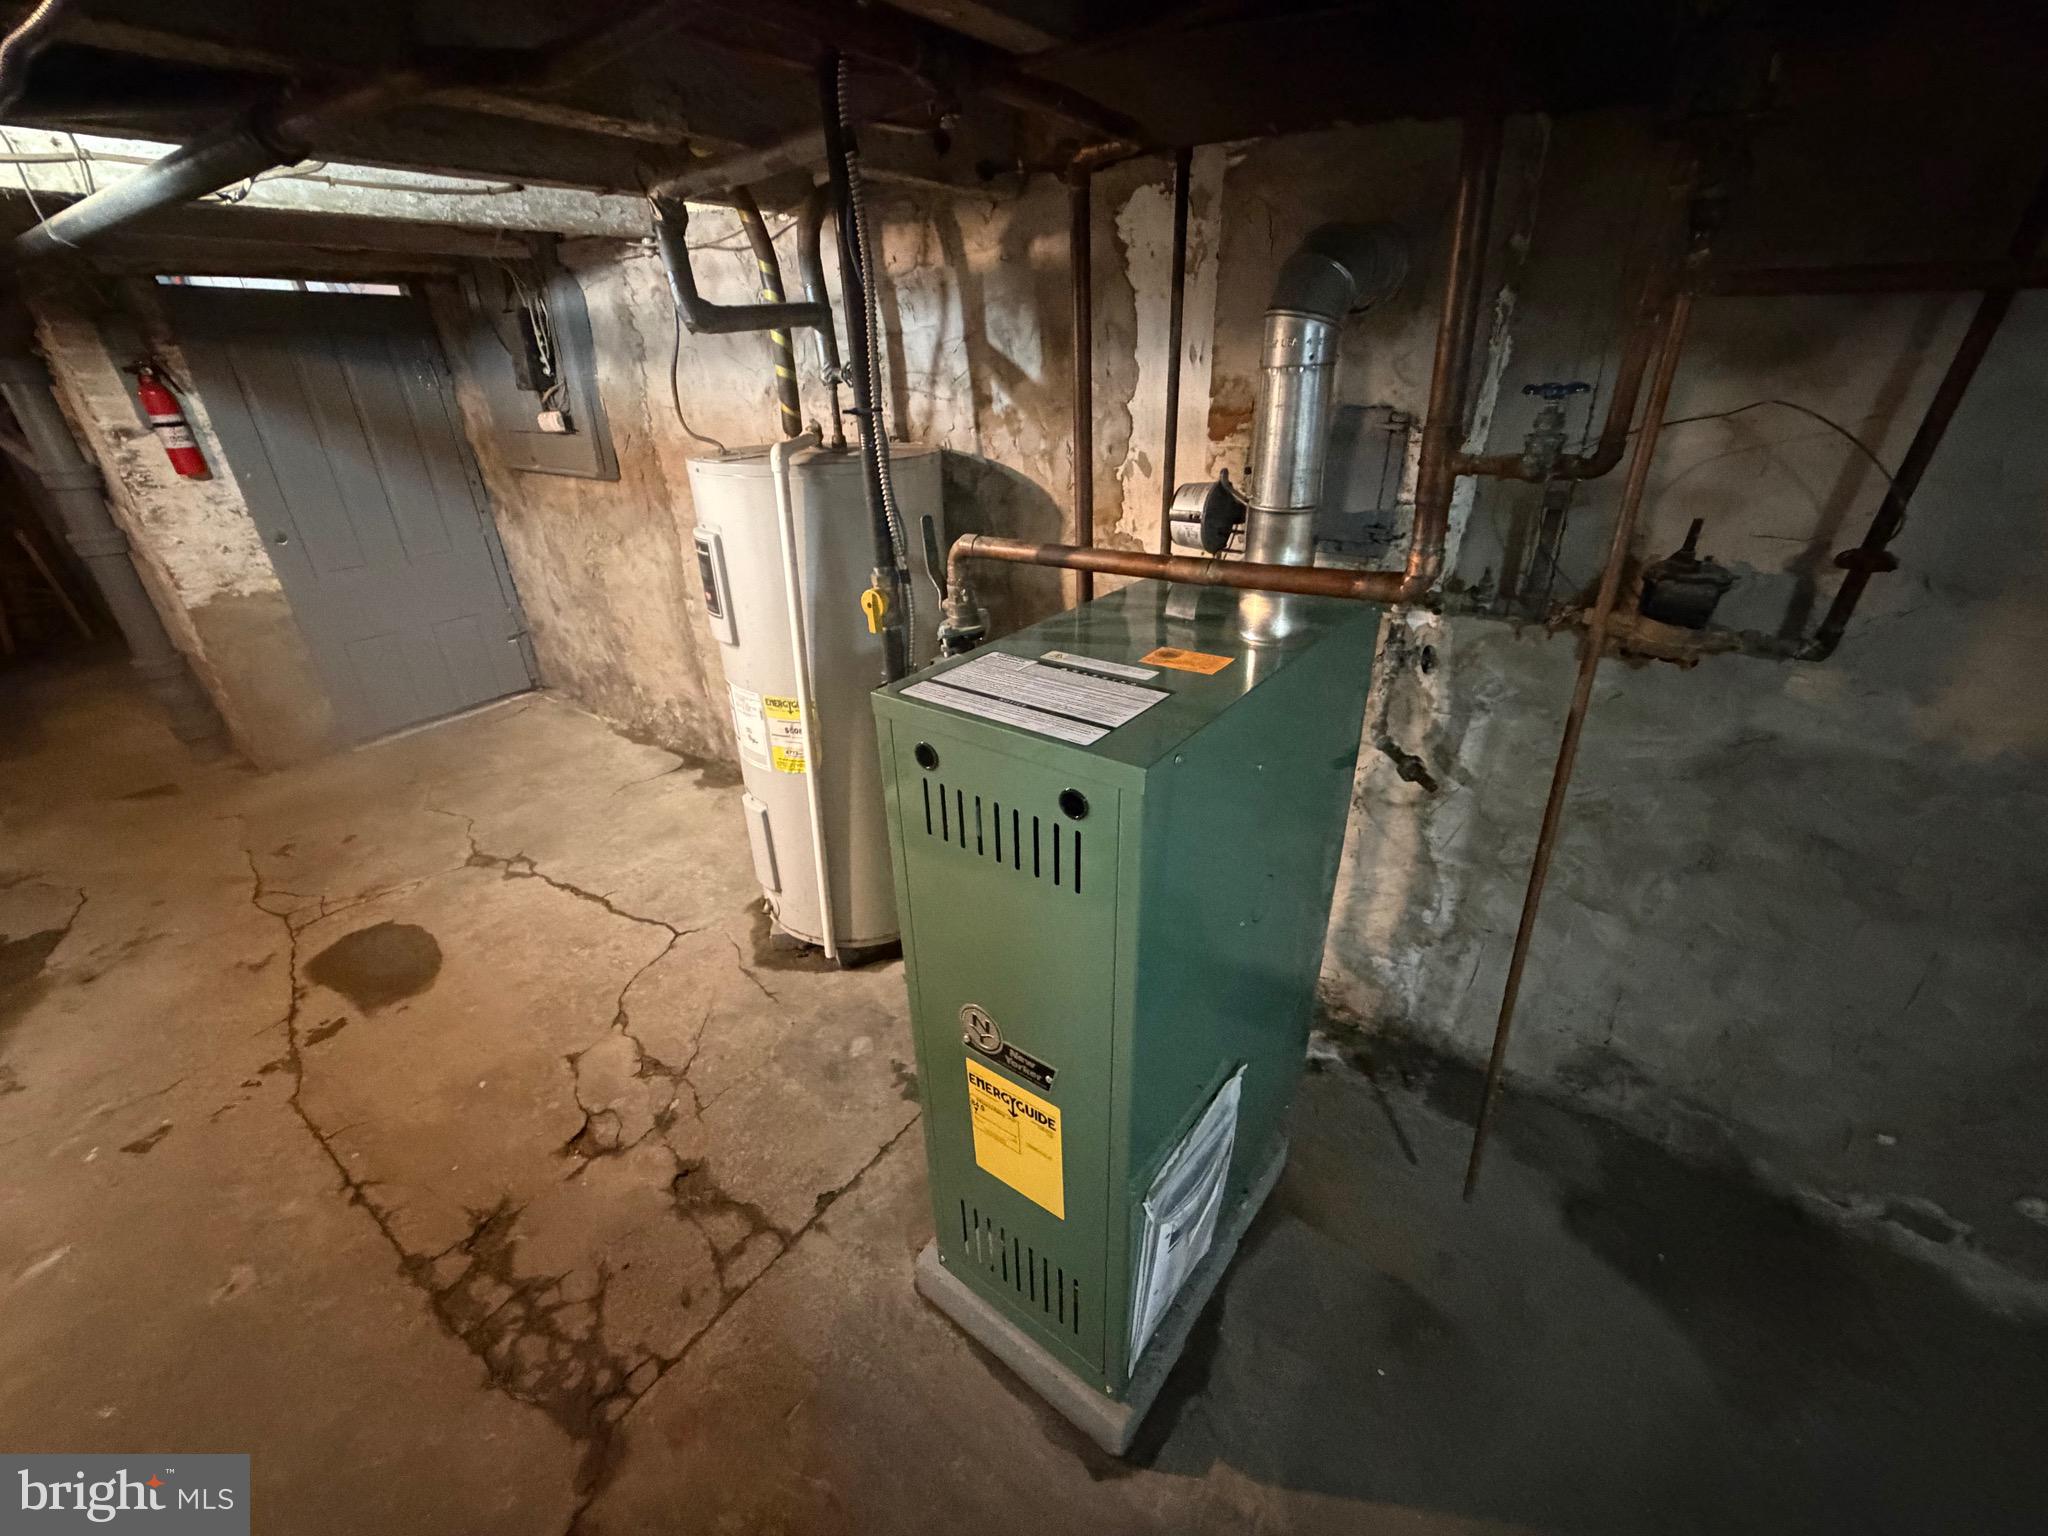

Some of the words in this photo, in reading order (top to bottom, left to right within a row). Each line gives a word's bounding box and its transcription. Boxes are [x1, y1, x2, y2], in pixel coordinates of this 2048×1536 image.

[1005, 1055, 1042, 1081] Yorker
[1008, 1048, 1036, 1068] New
[969, 1072, 1056, 1131] ENERGYGUIDE
